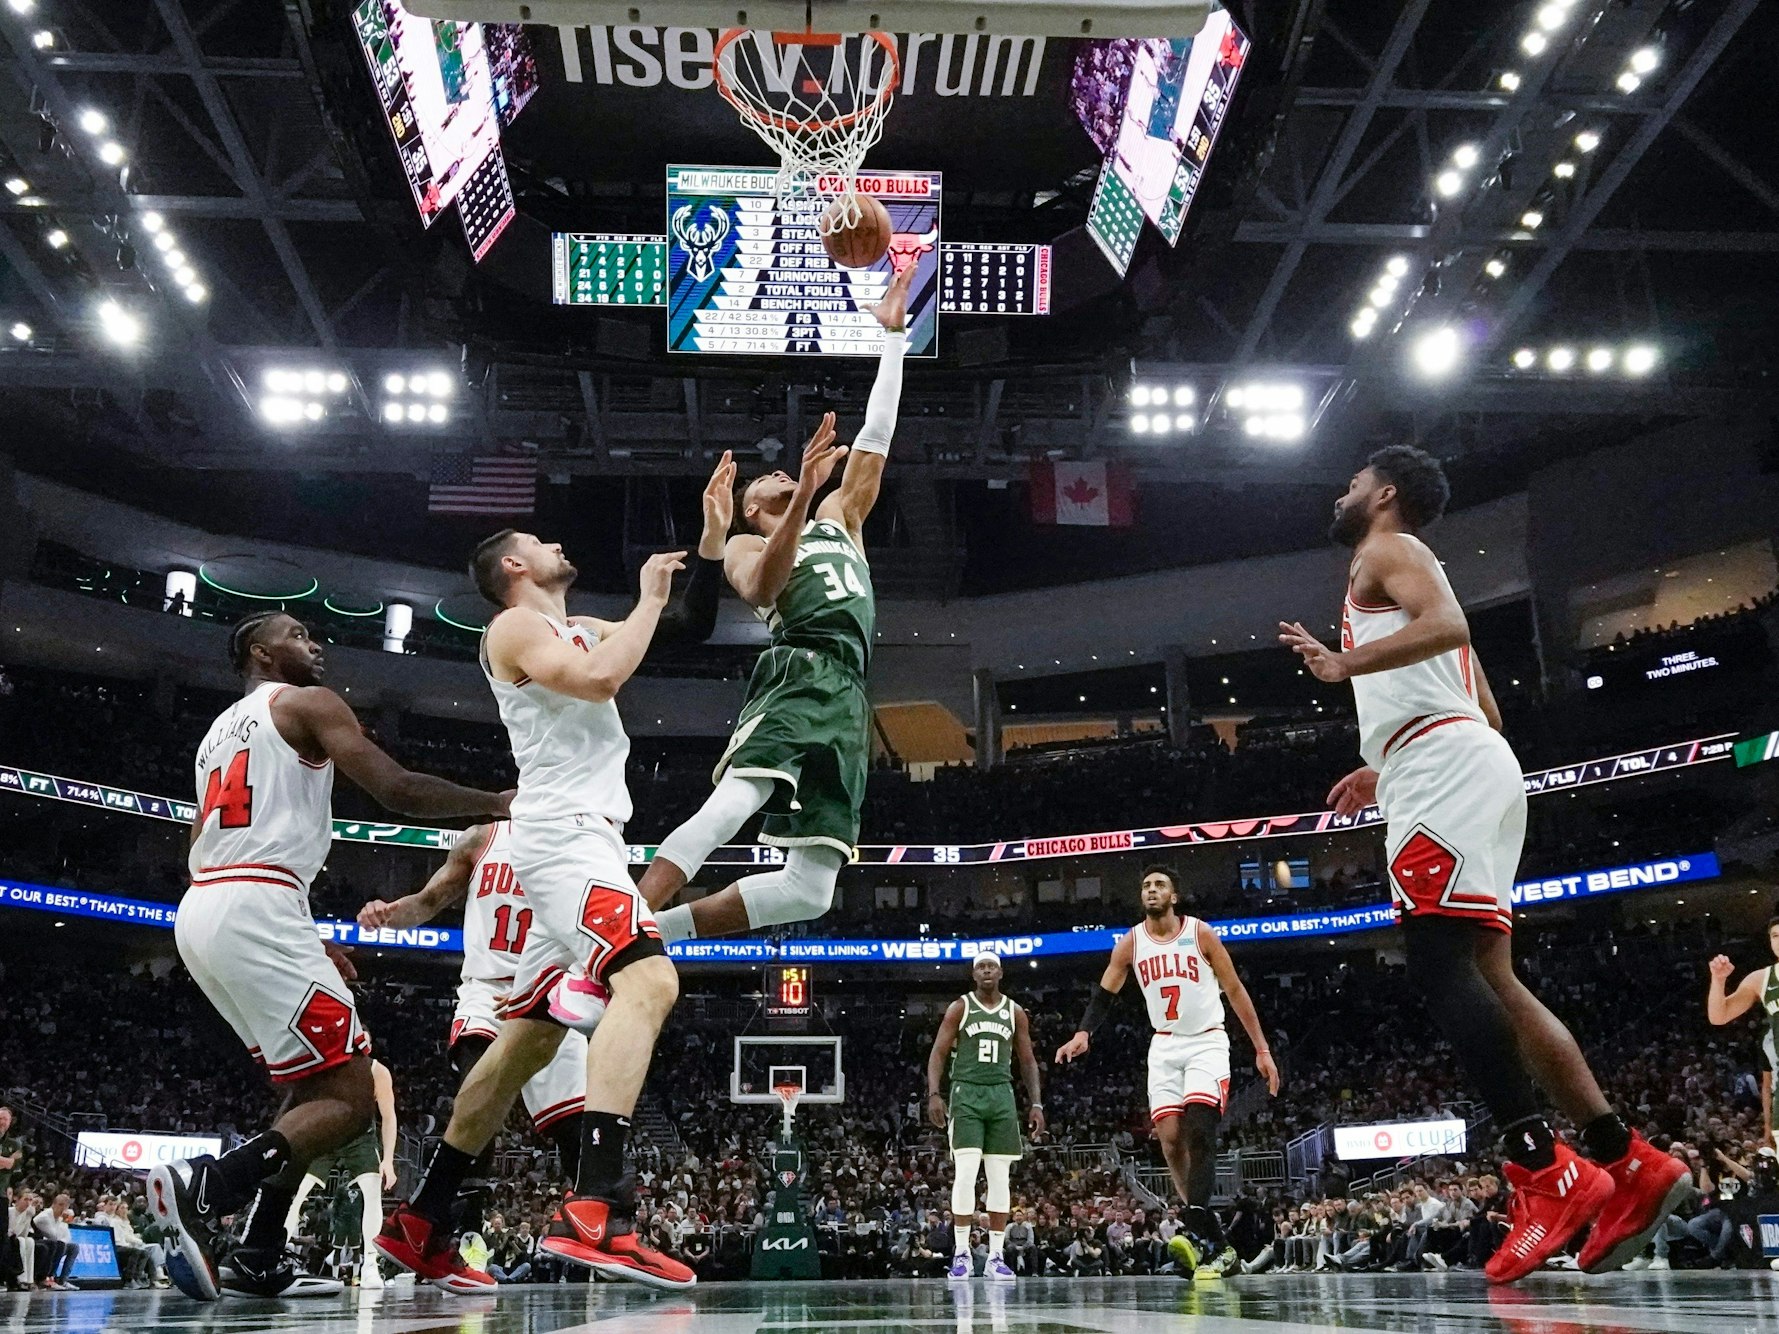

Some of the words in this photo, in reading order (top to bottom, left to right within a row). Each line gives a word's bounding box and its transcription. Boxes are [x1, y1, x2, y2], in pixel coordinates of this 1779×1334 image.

[681, 174, 747, 189] MILWAUKEE
[819, 177, 881, 193] CHIAGO
[887, 179, 929, 194] BULLS
[751, 201, 762, 209] 10
[781, 214, 820, 225] BLOCK
[781, 229, 820, 239] STEAL
[580, 244, 588, 253] 5
[780, 243, 803, 253] OFF
[581, 256, 587, 265] 7
[750, 257, 762, 265] 22
[780, 256, 803, 267] DEF
[805, 258, 829, 268] REB
[945, 252, 954, 262] 0
[963, 253, 972, 262] 11
[981, 253, 989, 263] 2
[1016, 254, 1025, 264] 0
[579, 268, 590, 278] 21
[946, 265, 953, 274] 7
[981, 266, 989, 275] 3
[998, 266, 1007, 276] 2
[1016, 266, 1024, 276] 0
[1040, 249, 1048, 284] CHICAGO
[768, 270, 840, 283] TURNOVERS
[963, 277, 971, 287] 2
[981, 278, 988, 287] 7
[577, 293, 592, 303] 34
[739, 285, 744, 293] 2
[765, 285, 803, 296] TOTAL
[804, 286, 843, 297] FOULS
[944, 289, 954, 299] 11
[962, 290, 971, 299] 2
[1015, 291, 1023, 300] 2
[760, 298, 801, 309] BENCH
[803, 300, 847, 311] POINTS
[941, 301, 956, 311] 44
[960, 302, 973, 311] 10
[1039, 287, 1048, 311] BULLS
[796, 314, 811, 323] FG
[792, 328, 815, 337] 3PT
[796, 342, 811, 351] FT
[812, 562, 867, 601] 34
[1662, 651, 1699, 666] THREE.
[1646, 668, 1671, 680] TWO
[1671, 656, 1719, 675] MINUTES.
[198, 715, 258, 770] WILLIAMS
[1549, 770, 1576, 785] FLS
[1594, 766, 1601, 776] 1
[1620, 757, 1651, 771] TOL
[1667, 752, 1677, 761] 4
[29, 778, 50, 791] FT
[67, 785, 99, 801] 71.4%
[107, 792, 134, 807] FLS
[151, 802, 159, 812] 2
[751, 847, 785, 863] 1:5
[933, 847, 960, 862] 35
[1027, 837, 1085, 857] CHICAGO
[1090, 834, 1132, 852] BULLS
[477, 863, 525, 899] BUL
[10, 888, 42, 903] OUR
[88, 899, 135, 917] THAT'S
[137, 907, 162, 921] THE
[489, 904, 533, 954] 11
[1231, 923, 1258, 936] OUT
[1261, 920, 1289, 933] OUR
[1331, 912, 1371, 927] THAT'S
[1372, 909, 1395, 923] THE
[316, 924, 353, 940] ST
[722, 945, 762, 956] THAT'S
[789, 945, 822, 956] SILVER
[881, 942, 957, 958] WEST
[783, 968, 806, 981] 1:51
[1138, 953, 1200, 988] BULLS
[783, 982, 802, 1004] 10
[1160, 985, 1180, 1020] 7
[965, 1021, 1012, 1040] MILWAUKEE
[978, 1039, 999, 1063] 21
[1406, 1128, 1455, 1147] CLUB
[762, 1237, 809, 1251] KIA
